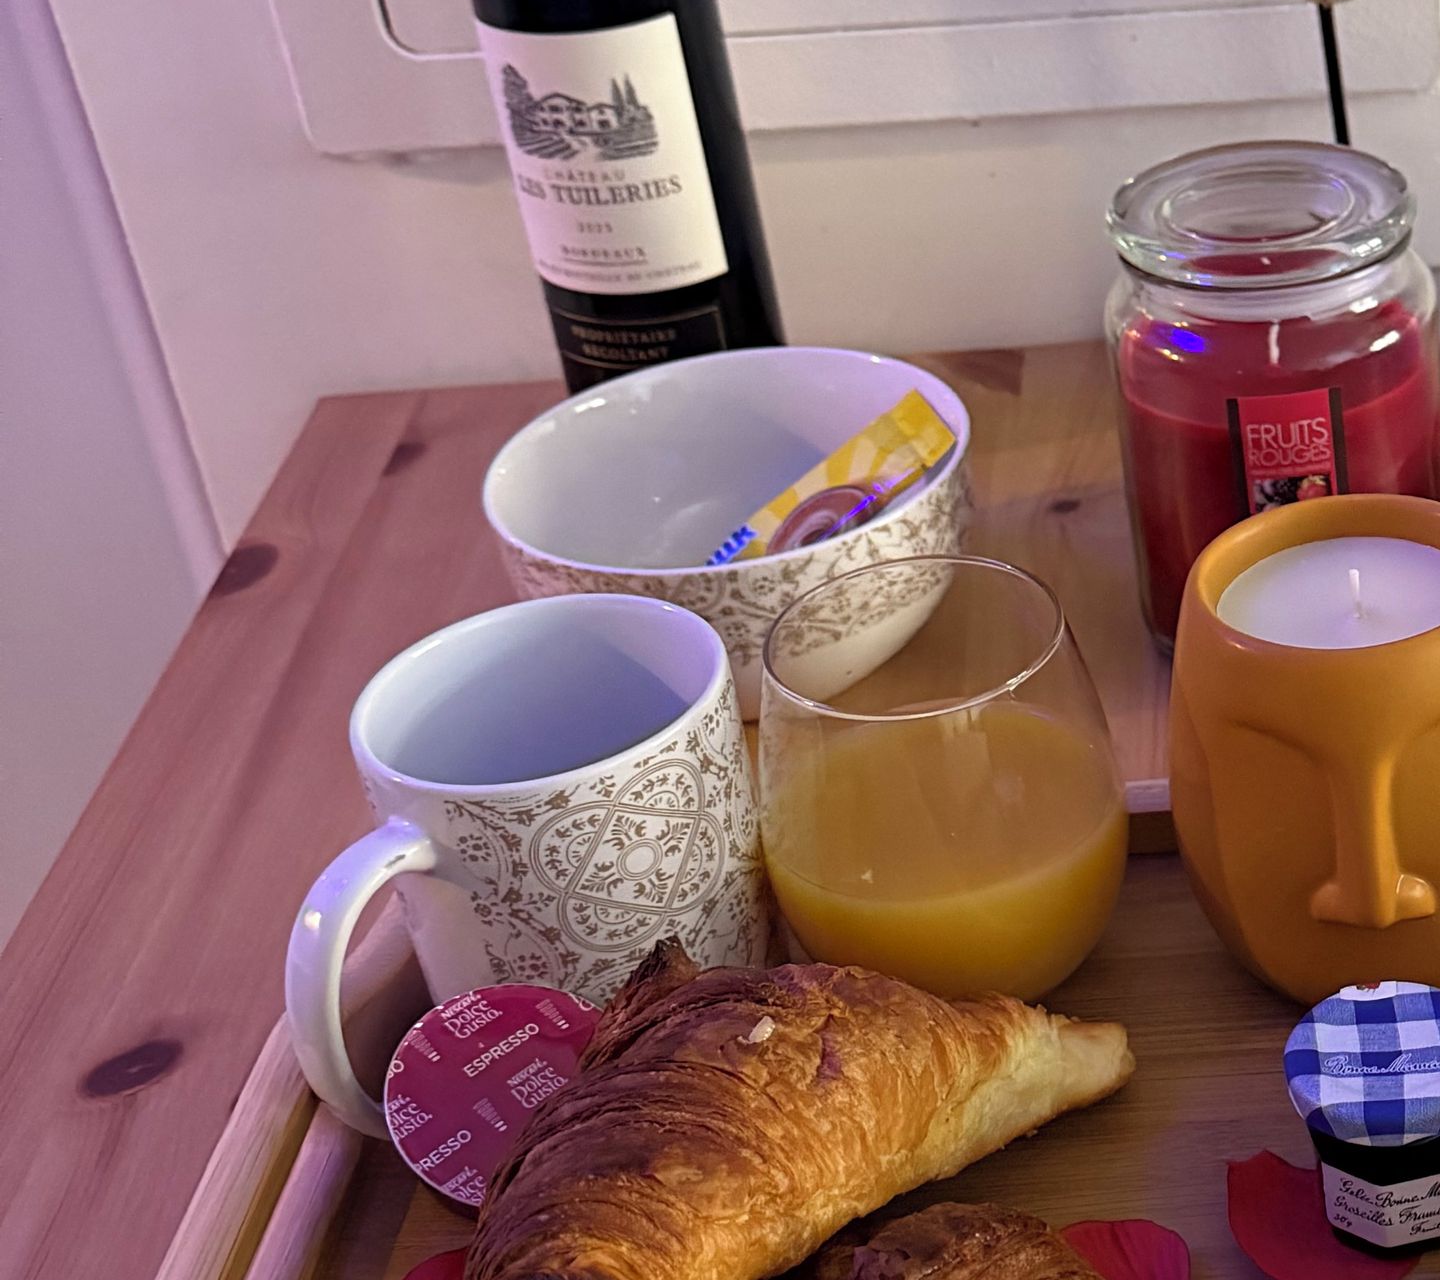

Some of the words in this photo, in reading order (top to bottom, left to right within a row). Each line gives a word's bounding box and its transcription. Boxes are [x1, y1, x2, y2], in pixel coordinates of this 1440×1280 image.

[550, 174, 683, 206] TUILERIES
[560, 243, 646, 259] BORDEAUX
[1245, 416, 1329, 451] FRUITS
[1247, 442, 1332, 468] ROUGES
[444, 1000, 491, 1033] Dolce
[455, 1008, 501, 1039] Gusto
[463, 1023, 540, 1078] ESPRESSO
[510, 1067, 557, 1101] Dolce
[521, 1076, 567, 1109] Gusto
[1334, 1195, 1394, 1227] Groseilles
